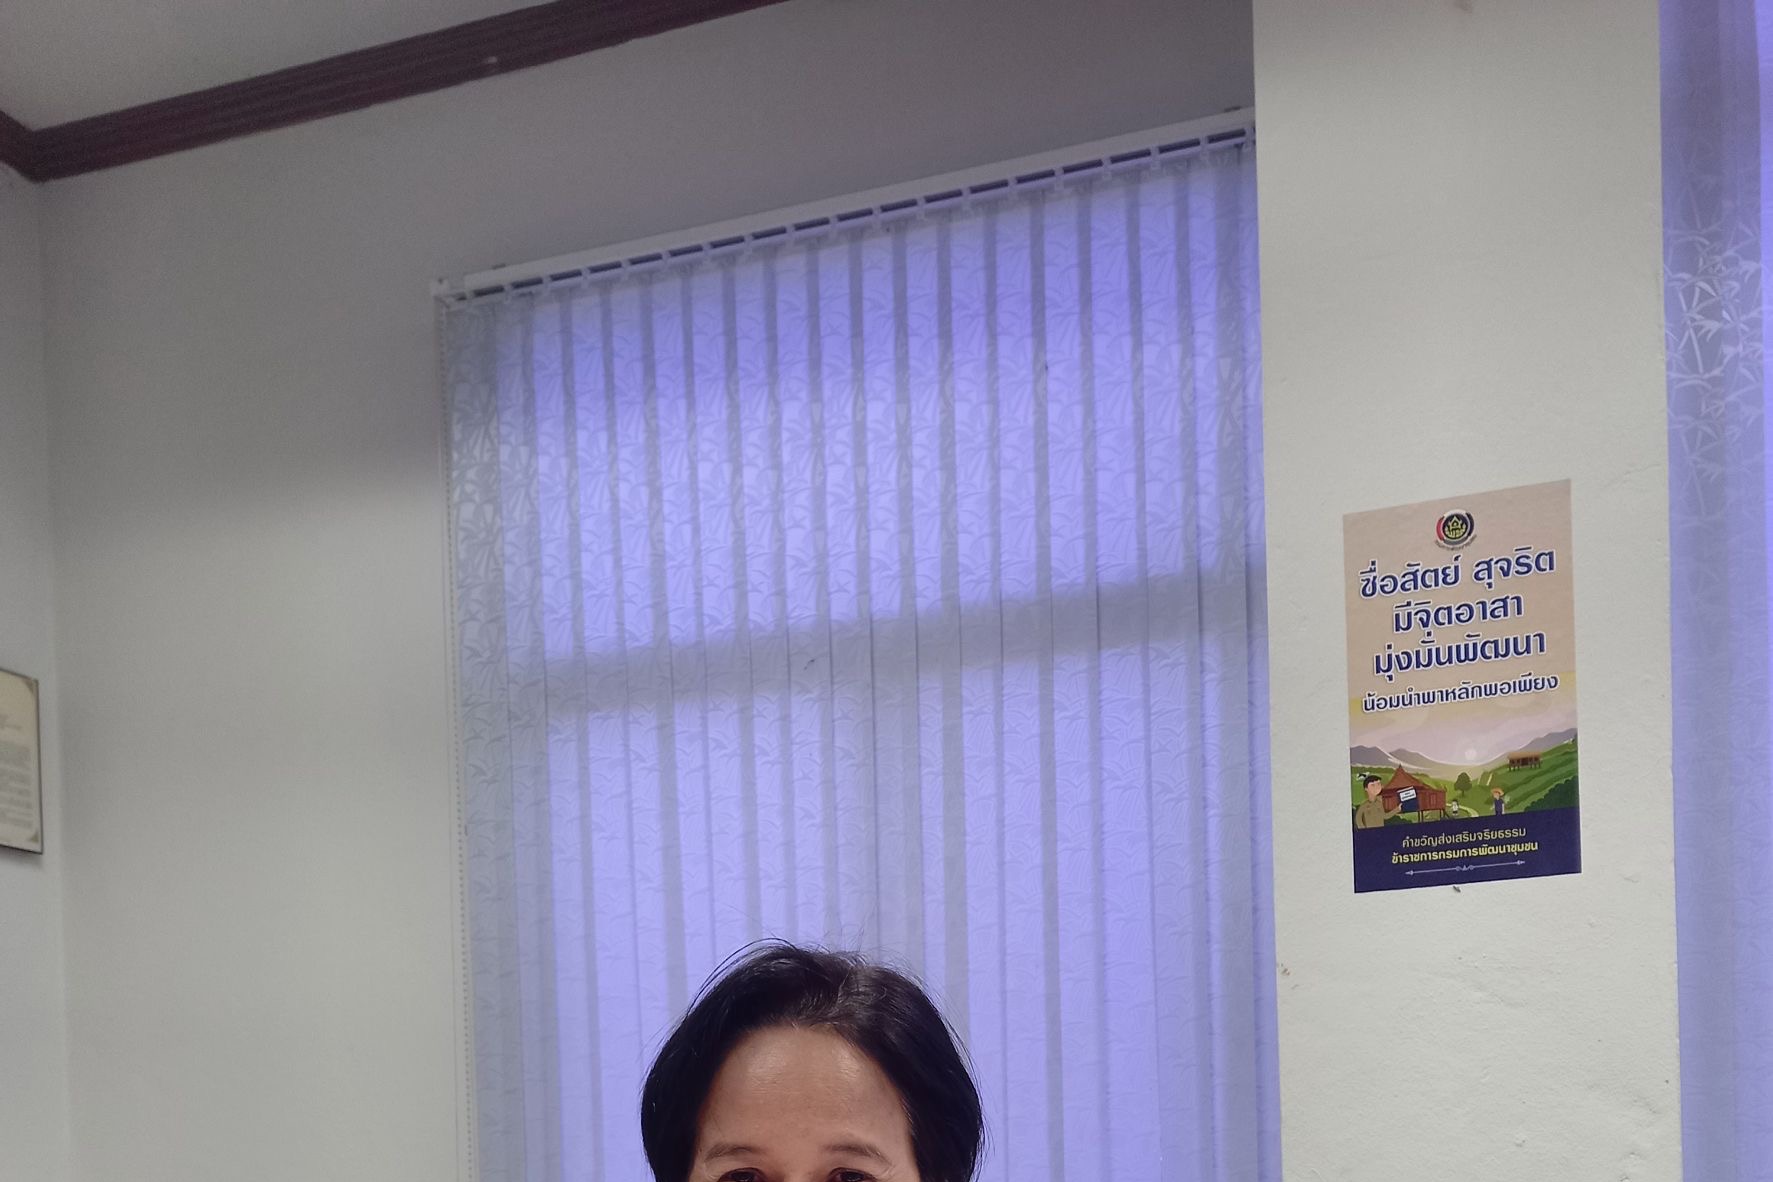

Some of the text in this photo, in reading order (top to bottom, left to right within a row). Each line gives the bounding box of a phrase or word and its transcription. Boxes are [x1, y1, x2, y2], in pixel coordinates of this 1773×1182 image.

[1360, 547, 1555, 597] ซื่อสัตย์ สุจริต
[1394, 595, 1523, 632] มีจิตอาสา
[1375, 631, 1545, 681] มุ่งมั่นพัฒนา
[1363, 672, 1559, 712] น้อมนำพาหลักพอเพียง
[1391, 841, 1539, 864] ข้าราชการกรมการพัฒนาชุมชน
[1402, 827, 1527, 848] คำขวัญส่งเสริมจริยธรรม
